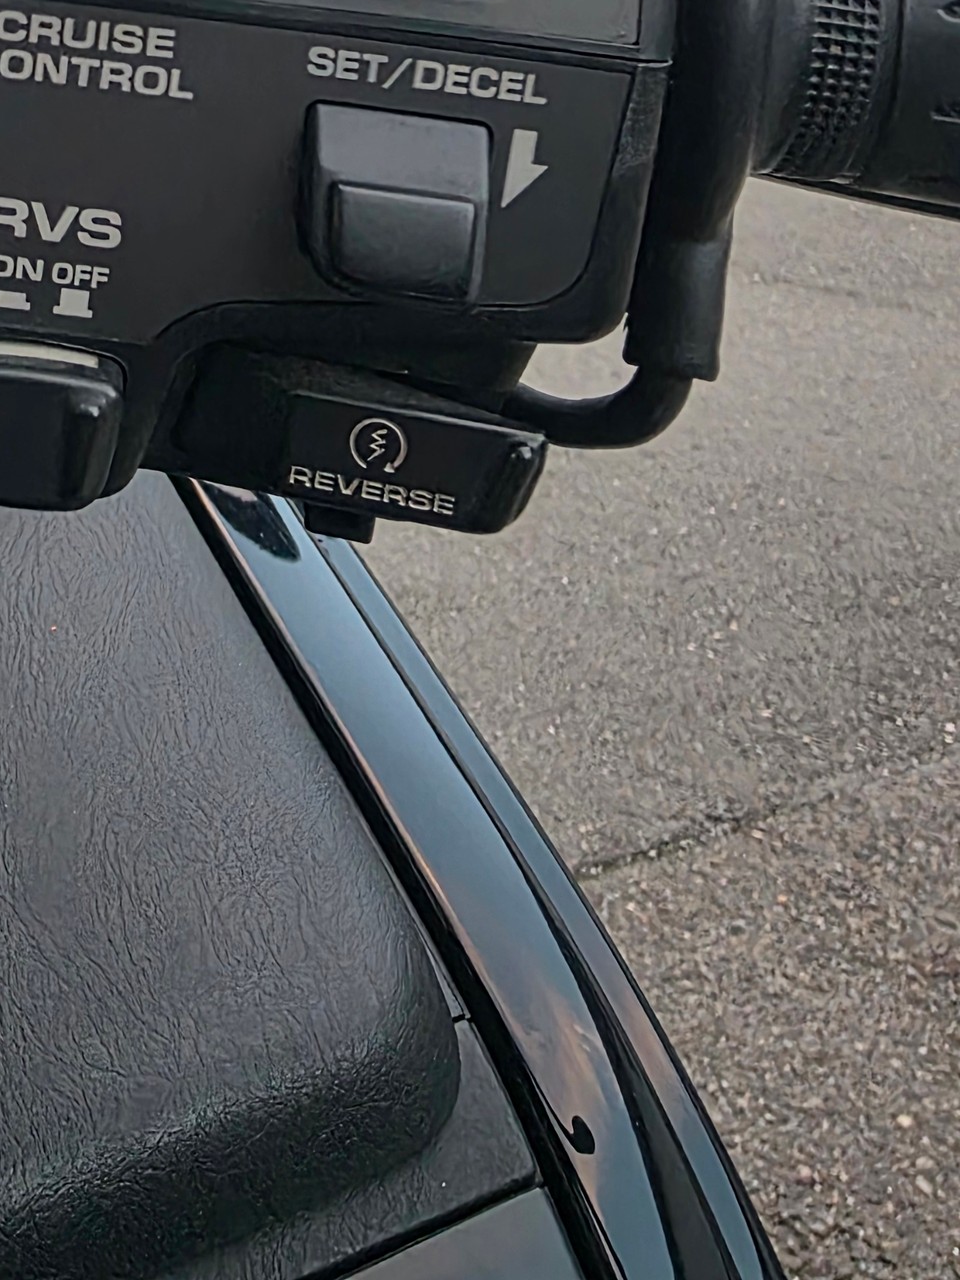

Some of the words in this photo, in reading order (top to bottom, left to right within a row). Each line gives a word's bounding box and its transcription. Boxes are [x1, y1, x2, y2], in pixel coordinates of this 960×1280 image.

[306, 46, 548, 106] SET/DECEL
[52, 260, 109, 289] OFF
[289, 465, 456, 516] REVERSE
